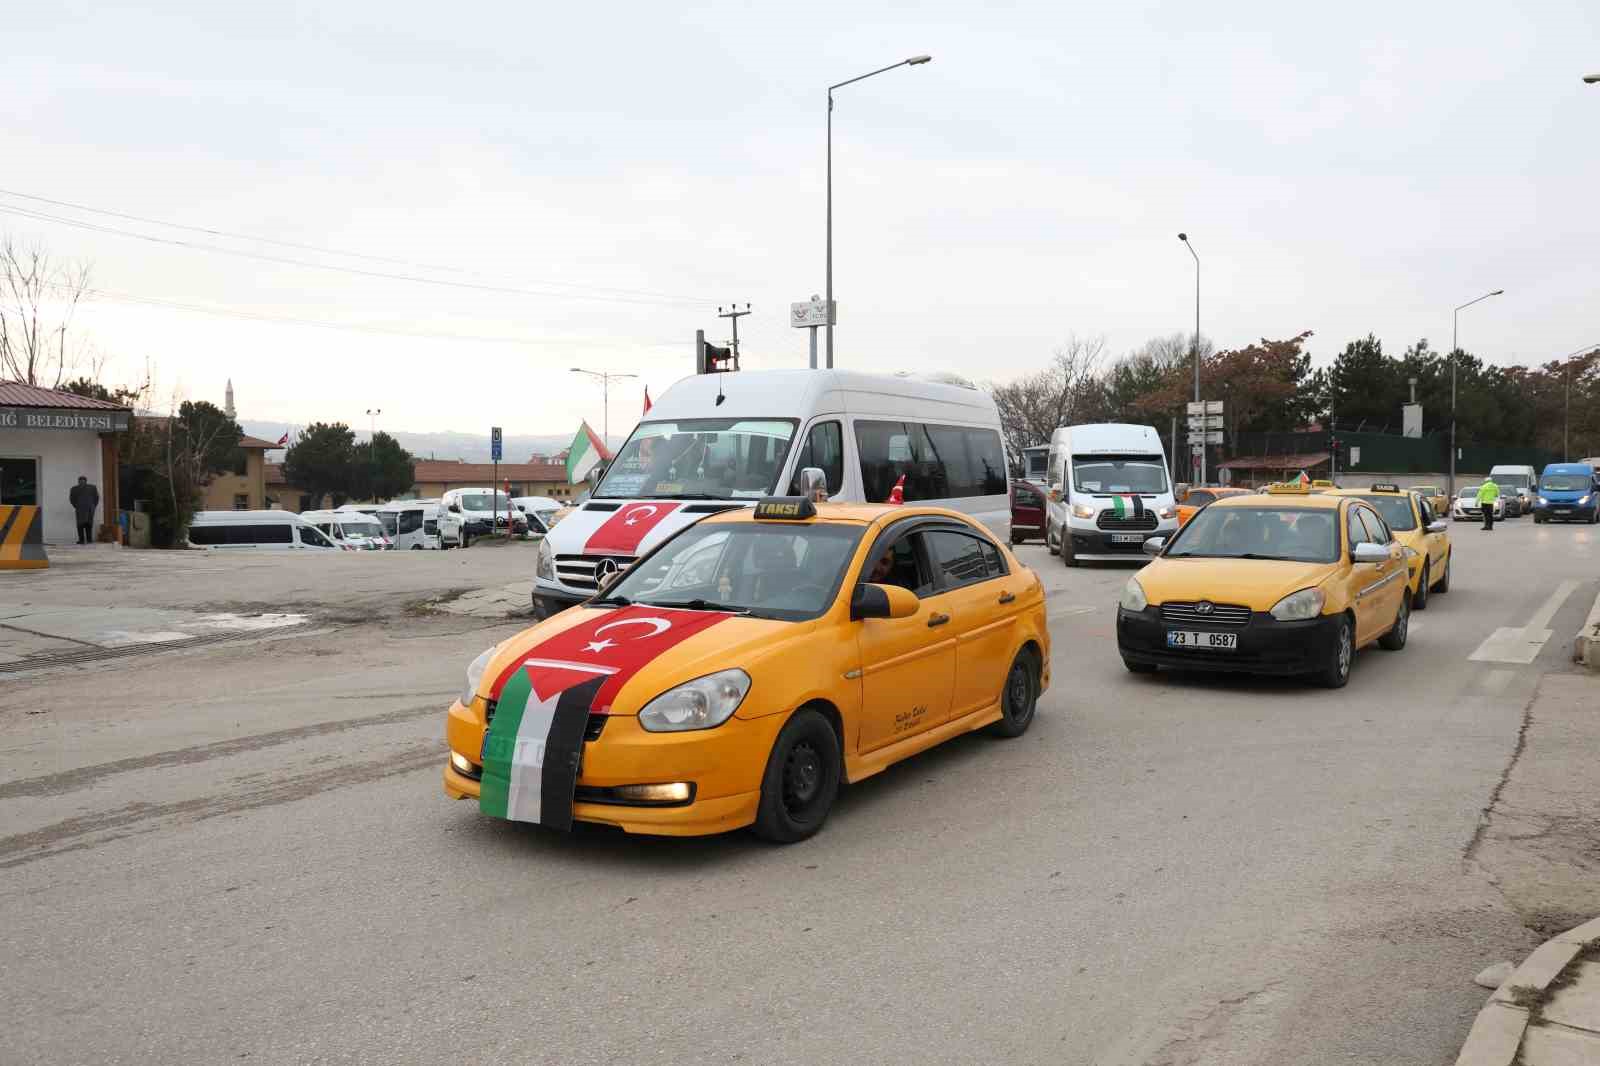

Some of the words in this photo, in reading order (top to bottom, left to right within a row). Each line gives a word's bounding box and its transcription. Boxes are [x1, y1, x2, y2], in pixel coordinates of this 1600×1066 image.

[0, 411, 17, 426] IĞ
[1173, 632, 1186, 644] 23
[1193, 632, 1199, 645] T
[1209, 634, 1236, 647] 0587
